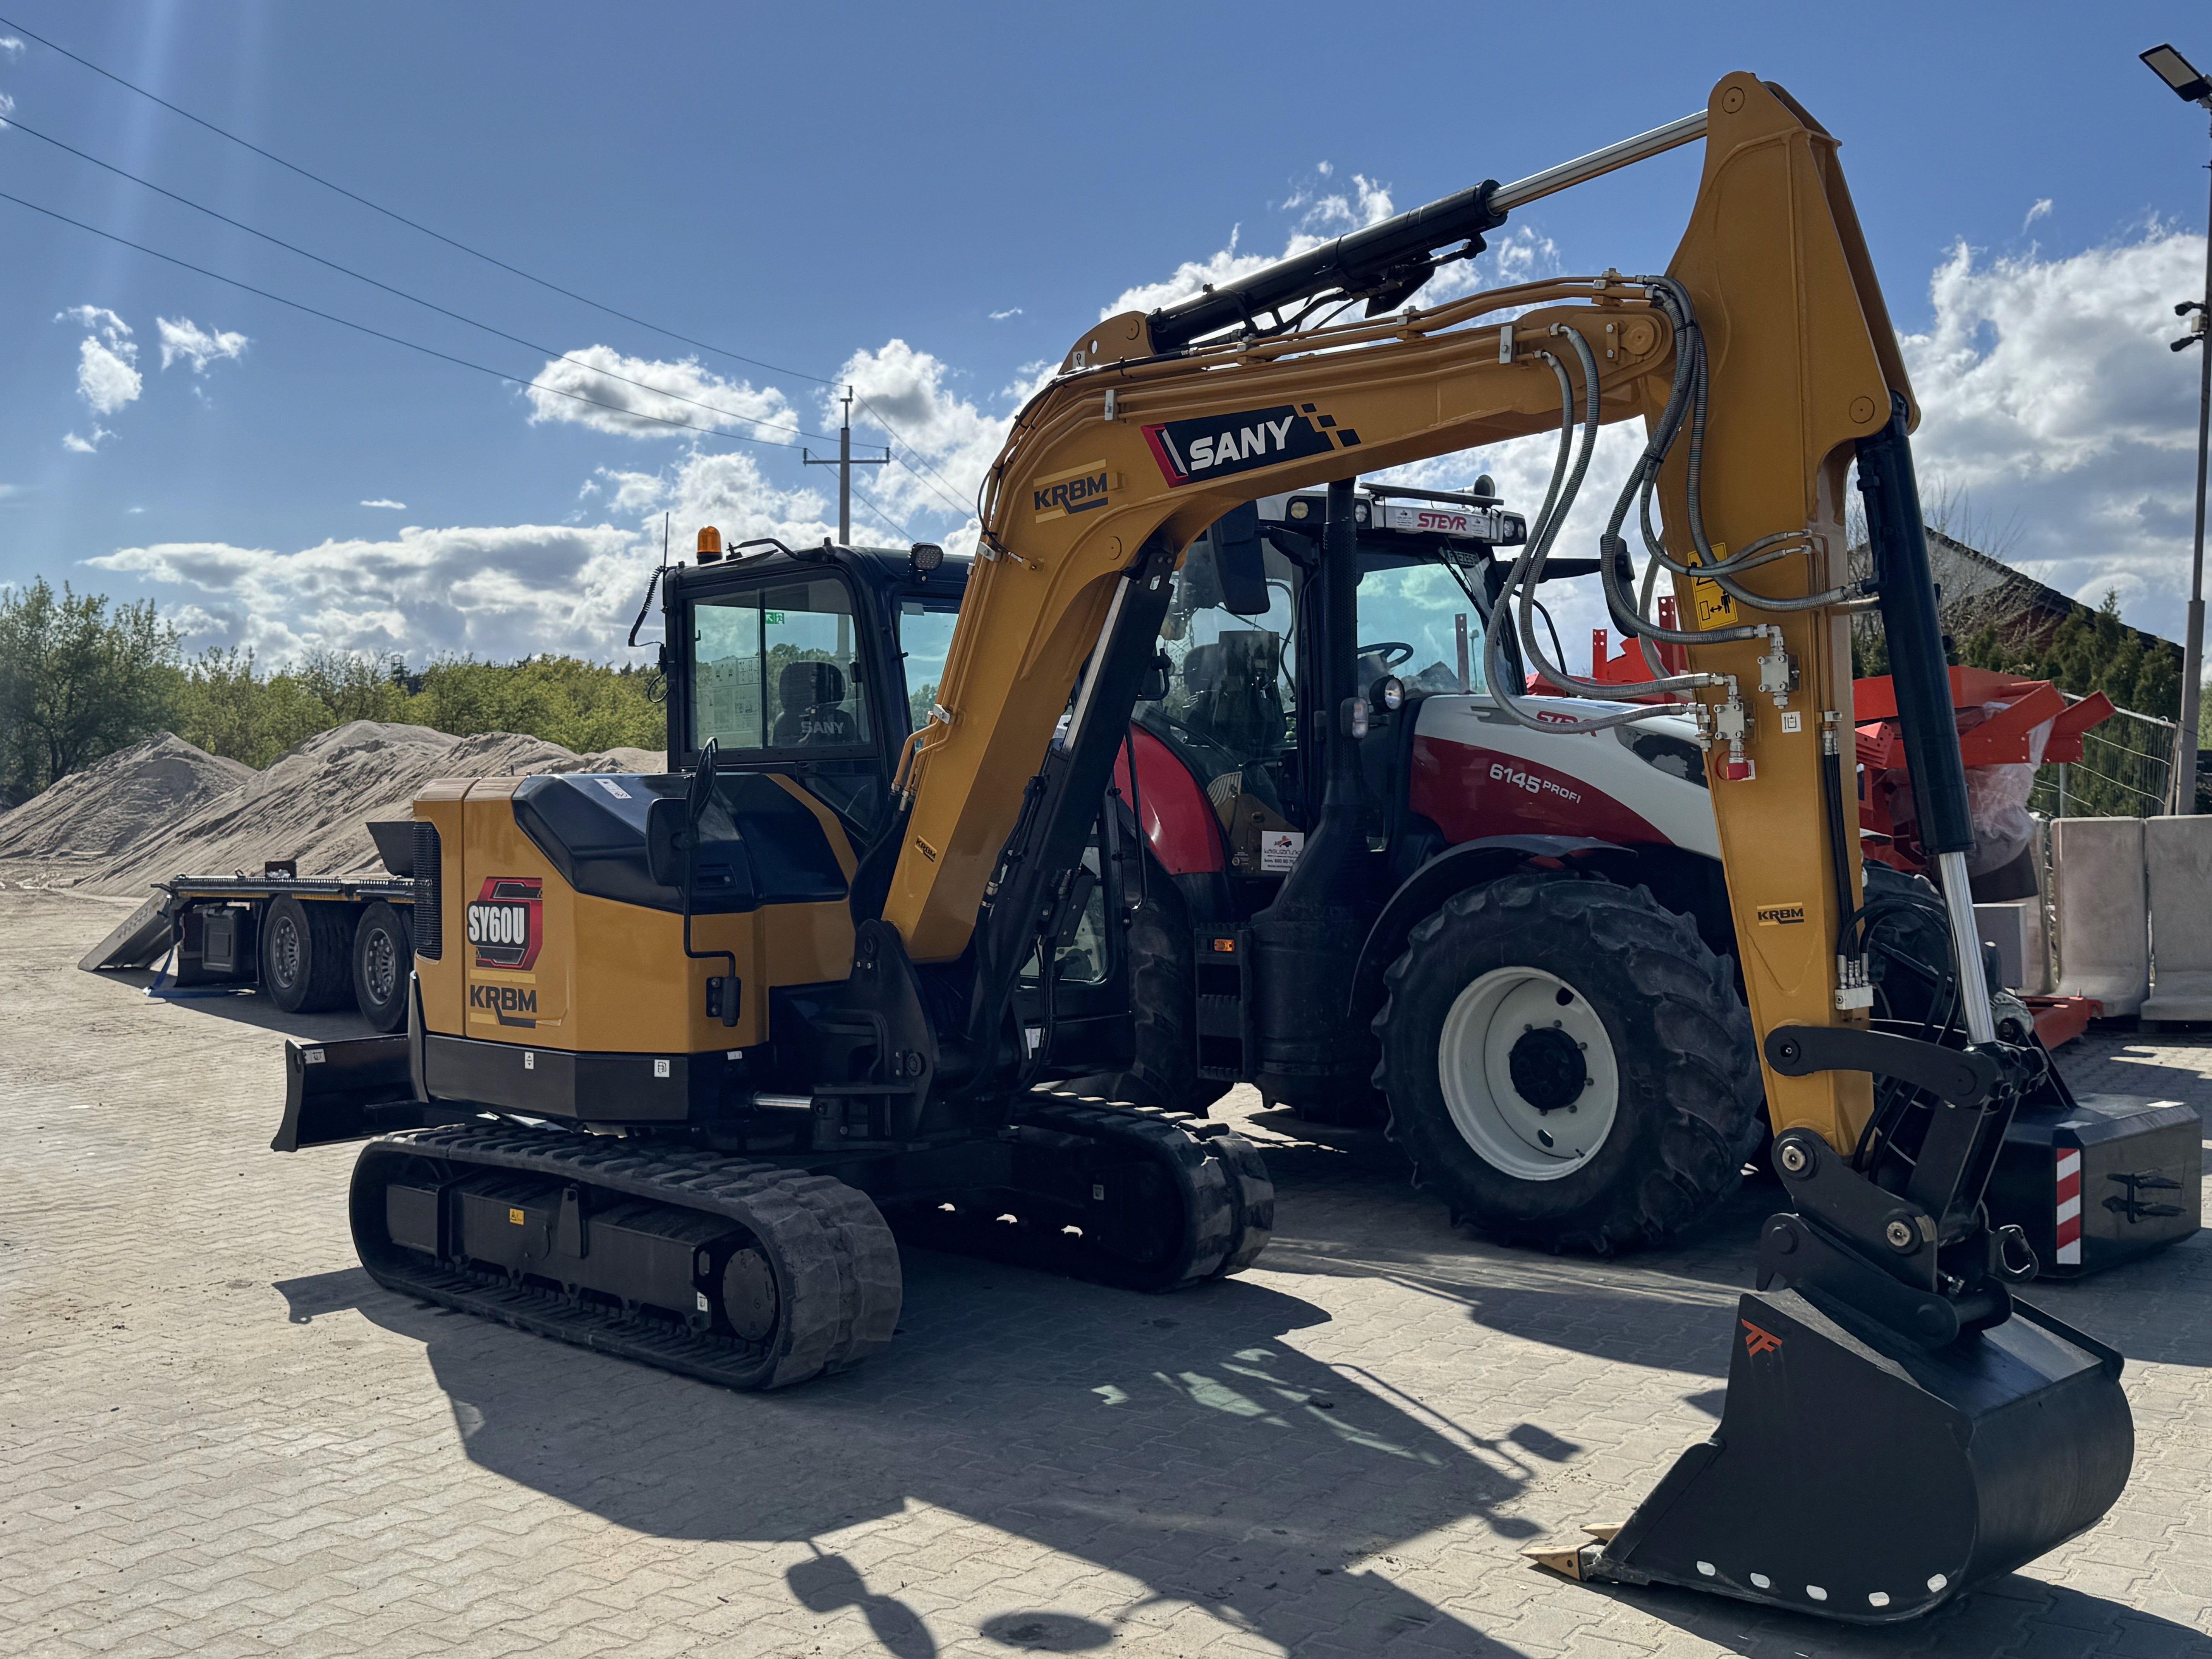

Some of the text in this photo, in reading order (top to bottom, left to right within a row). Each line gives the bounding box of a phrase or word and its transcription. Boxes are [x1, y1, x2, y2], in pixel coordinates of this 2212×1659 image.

[1190, 415, 1294, 471] SANY
[1034, 472, 1109, 514] KRBM
[1417, 513, 1467, 531] STEYR
[801, 721, 844, 734] SANY
[1490, 763, 1581, 804] 6145 PROFI
[916, 838, 936, 862] KRBM
[469, 905, 525, 944] SY60U
[1757, 908, 1805, 924] KRBM
[470, 985, 537, 1029] KRBM
